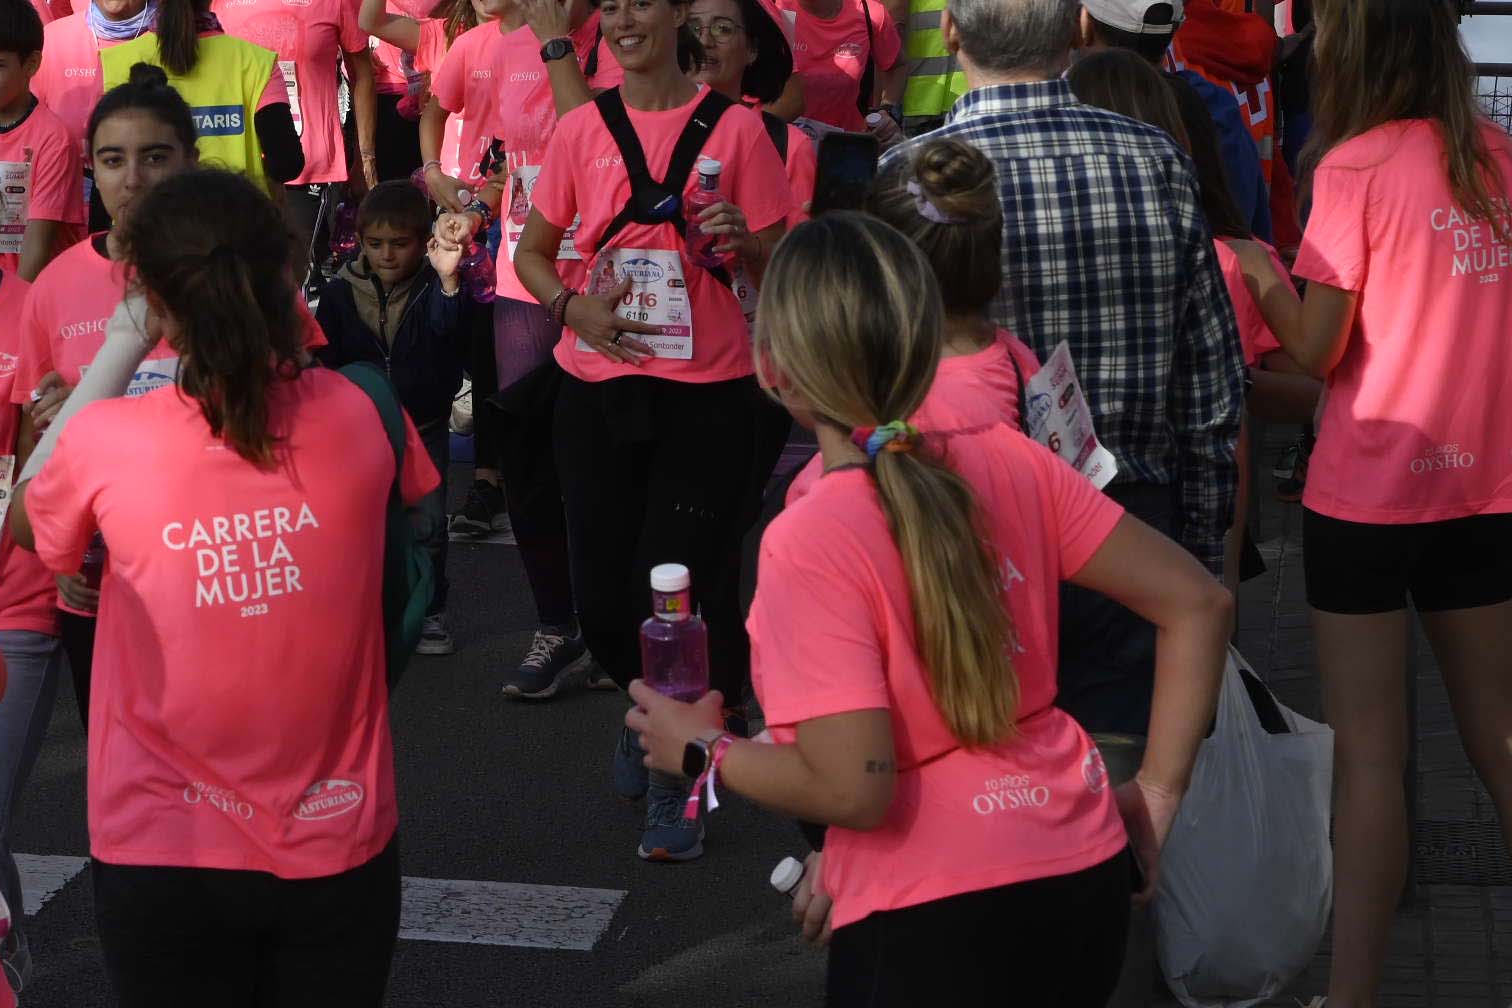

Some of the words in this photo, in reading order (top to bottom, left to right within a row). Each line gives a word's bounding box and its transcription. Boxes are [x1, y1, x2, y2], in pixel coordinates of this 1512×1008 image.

[1452, 228, 1482, 252] DE
[622, 292, 657, 308] 016
[625, 310, 648, 322] 6110
[649, 342, 685, 351] Santander
[1409, 452, 1474, 474] OYSHO
[162, 502, 320, 552] CARRERA
[196, 544, 240, 578] DE
[251, 537, 294, 570] LA
[194, 565, 304, 609] MUJER
[240, 603, 270, 618] 2023
[297, 790, 360, 817] ASTURIANA
[972, 785, 1050, 816] OYSHO
